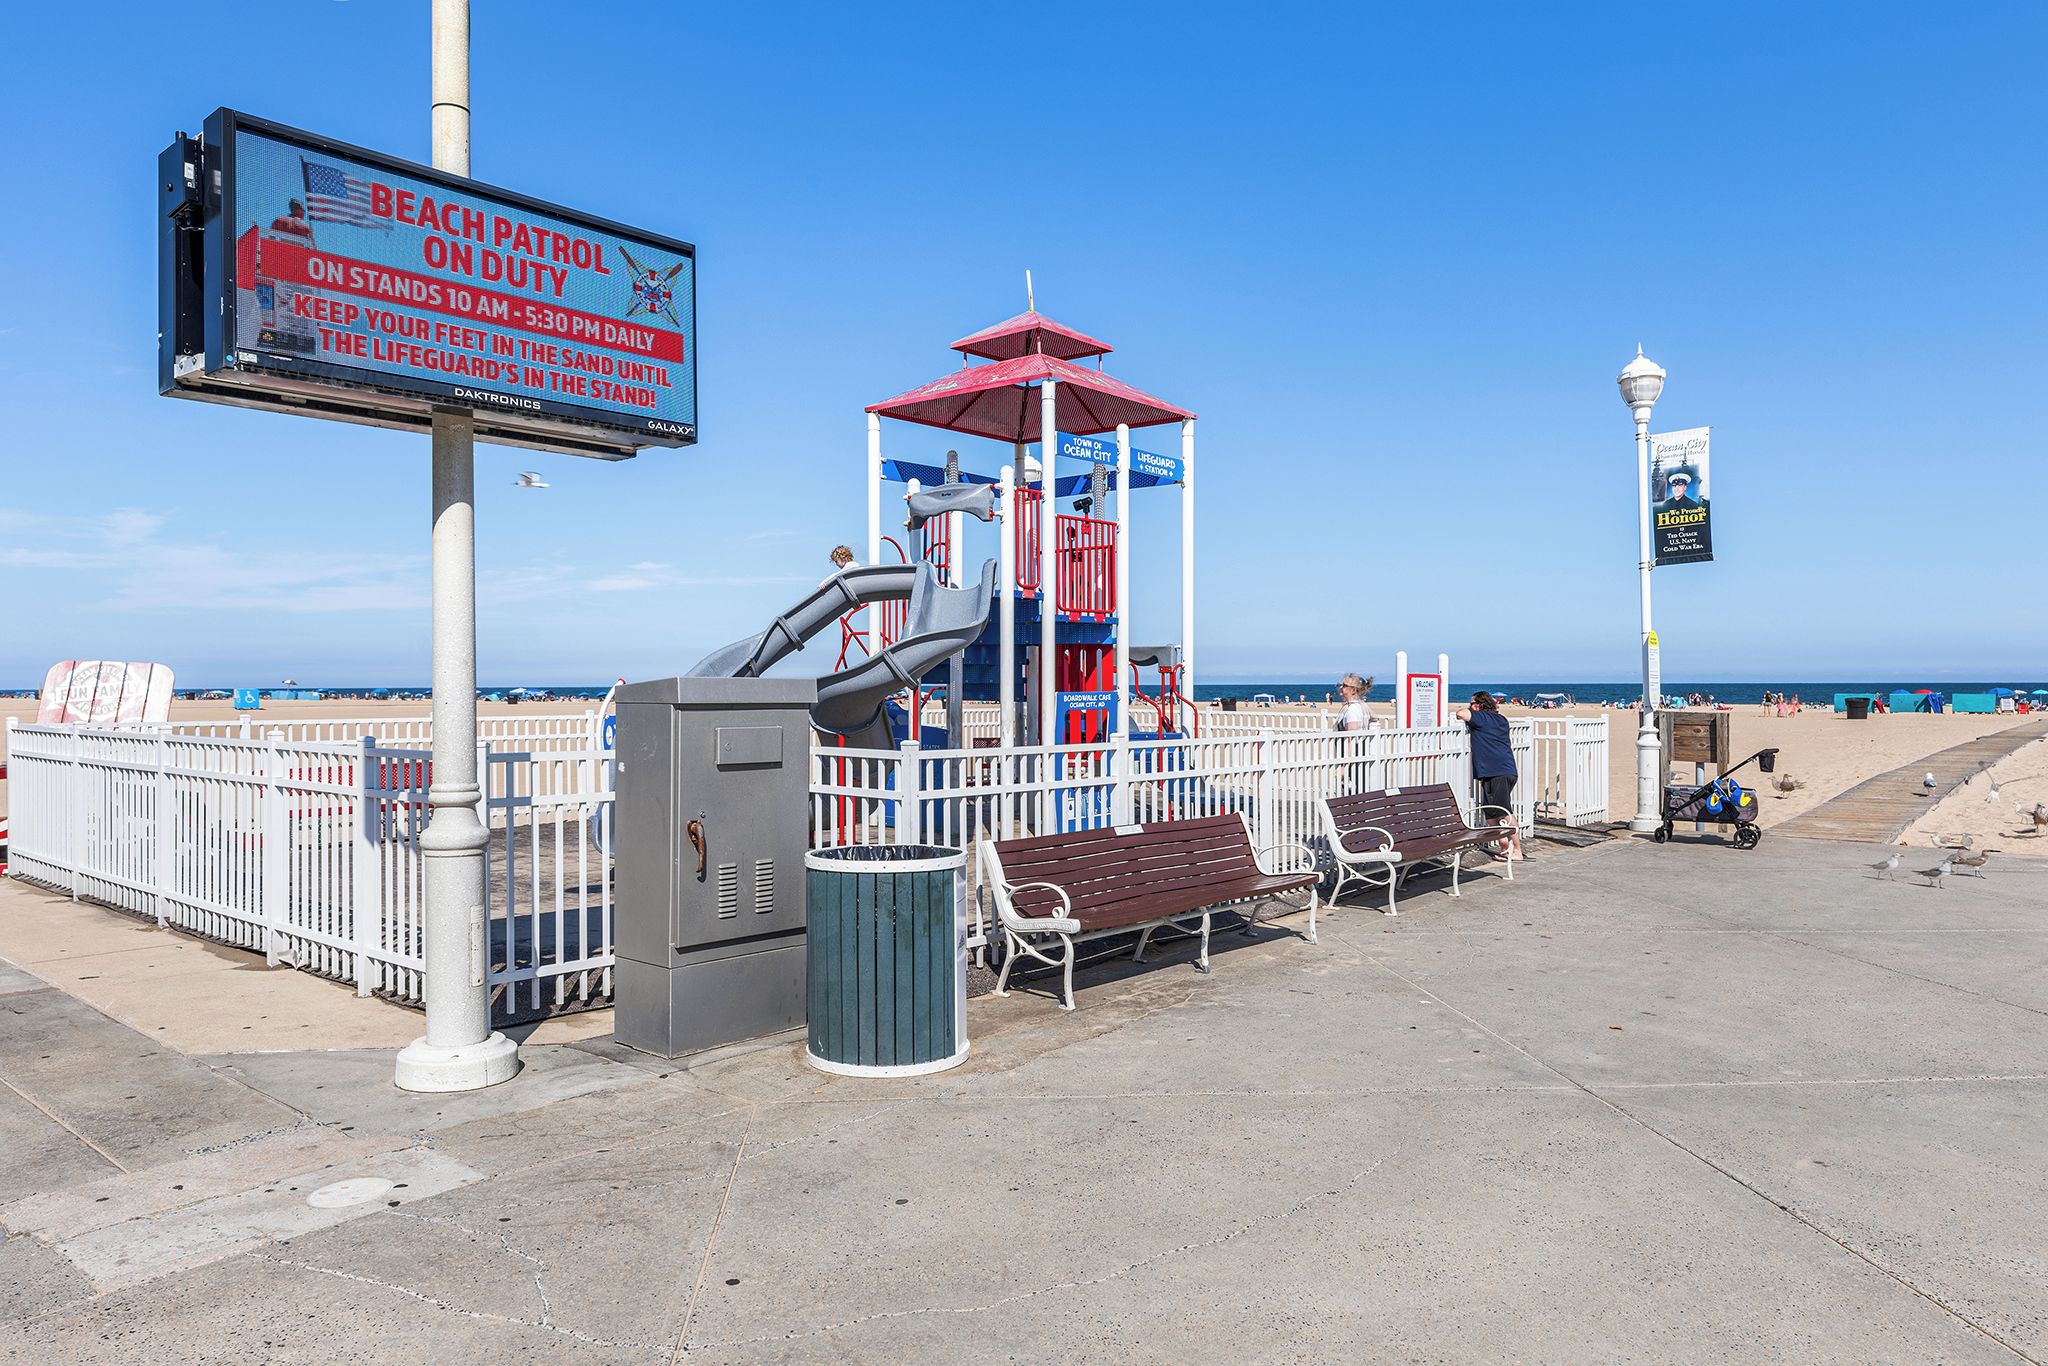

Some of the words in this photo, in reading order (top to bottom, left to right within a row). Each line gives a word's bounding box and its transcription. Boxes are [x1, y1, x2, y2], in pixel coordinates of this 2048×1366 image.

[370, 182, 485, 243] BEACH
[493, 215, 611, 276] PATROL
[423, 234, 473, 277] ON
[481, 248, 569, 299] DUTY
[307, 257, 344, 285] ON
[350, 267, 442, 305] STANDS
[447, 288, 472, 312] 10
[476, 296, 509, 320] AM
[525, 306, 568, 332] 5:30
[573, 316, 600, 340] PM
[604, 323, 655, 351] DAILY
[293, 292, 360, 326] KEEP
[364, 307, 430, 342] YOUR
[434, 323, 488, 351] FEET
[492, 333, 514, 357] IN
[518, 338, 558, 367] THE
[561, 348, 614, 376] SAND
[617, 359, 672, 388] UNTIL
[318, 327, 368, 358] THE
[373, 337, 519, 385] LIFEGUARD'S
[523, 366, 545, 389] IN
[548, 369, 587, 397] THE
[590, 379, 657, 409] STAND!
[454, 387, 541, 410] DAKTRONICS
[647, 420, 694, 435] GALAXY
[1063, 443, 1091, 458] OCEAN
[1093, 451, 1112, 463] CITY
[1073, 437, 1092, 448] TOWN
[1093, 442, 1102, 450] OF
[1657, 444, 1685, 453] Ocean
[1687, 438, 1707, 451] City
[1137, 452, 1176, 469] LIFEGUARD
[1145, 464, 1168, 476] STATION
[1657, 512, 1706, 526] Honor
[1681, 506, 1706, 515] Proudly
[60, 686, 88, 701] FUN
[95, 682, 140, 700] AMLY
